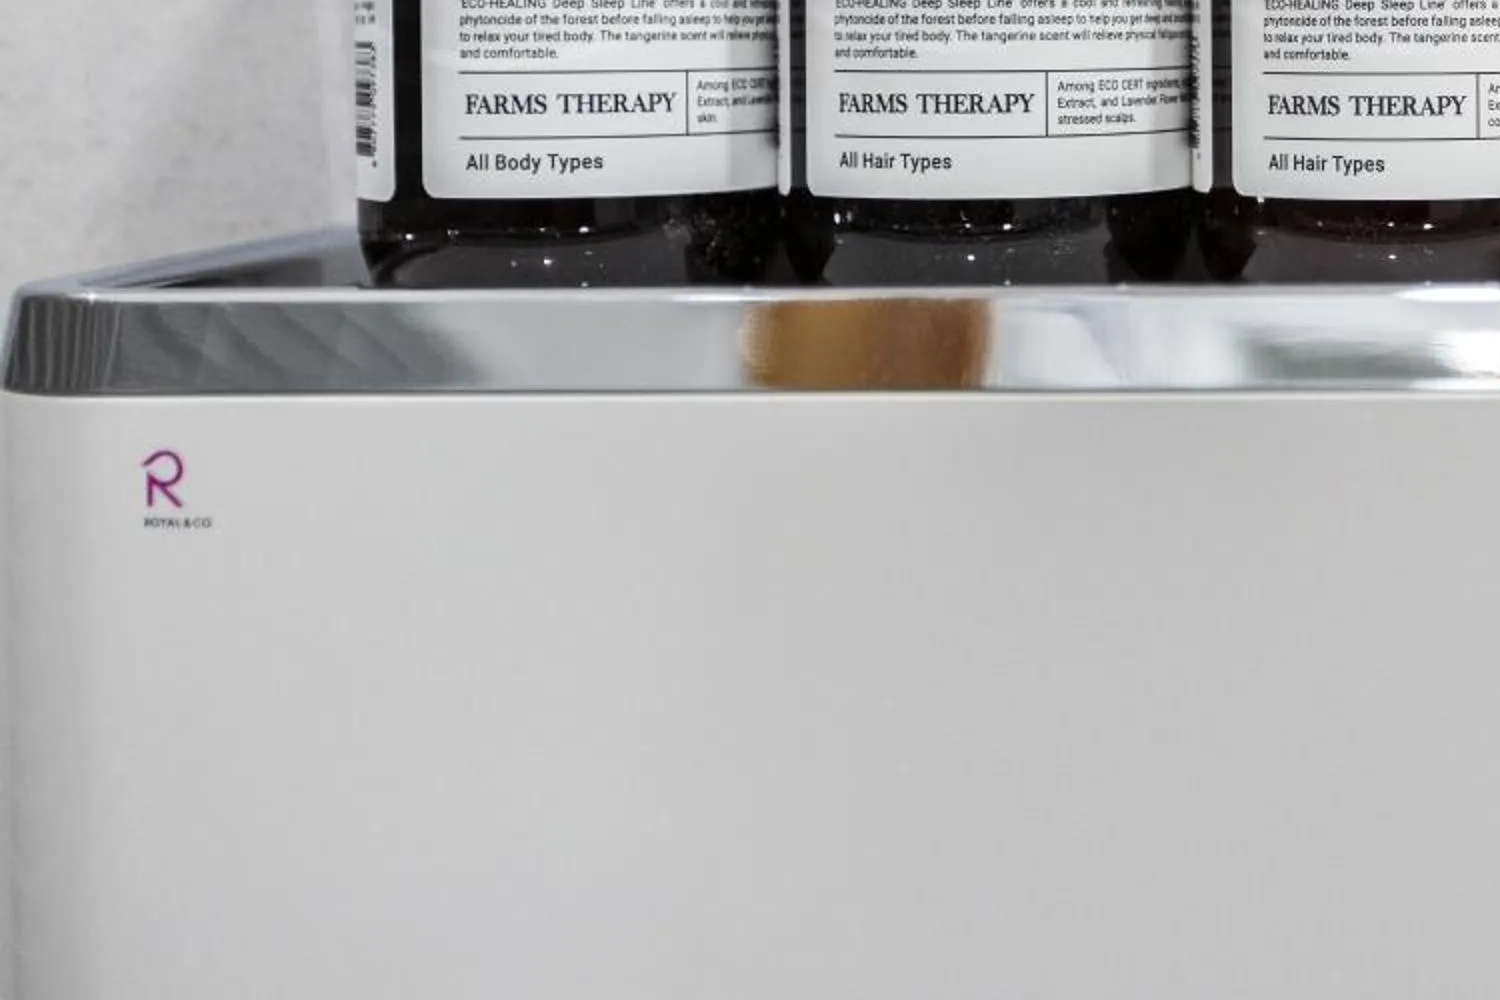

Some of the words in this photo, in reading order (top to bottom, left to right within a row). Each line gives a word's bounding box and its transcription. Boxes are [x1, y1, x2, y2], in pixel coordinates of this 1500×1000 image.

[465, 94, 548, 115] FARMS
[556, 92, 678, 114] THERAPY
[839, 93, 908, 113] FARMS
[915, 92, 1036, 115] THERAPY
[1268, 95, 1340, 116] FARMS
[1349, 95, 1467, 117] THERAPY
[466, 154, 489, 170] All
[495, 154, 540, 174] Body
[548, 153, 603, 174] Types
[840, 153, 858, 168] All
[863, 153, 895, 169] Hair
[901, 153, 952, 172] Types
[1269, 155, 1288, 171] All
[1293, 155, 1327, 171] Hair
[1333, 155, 1385, 175] Types
